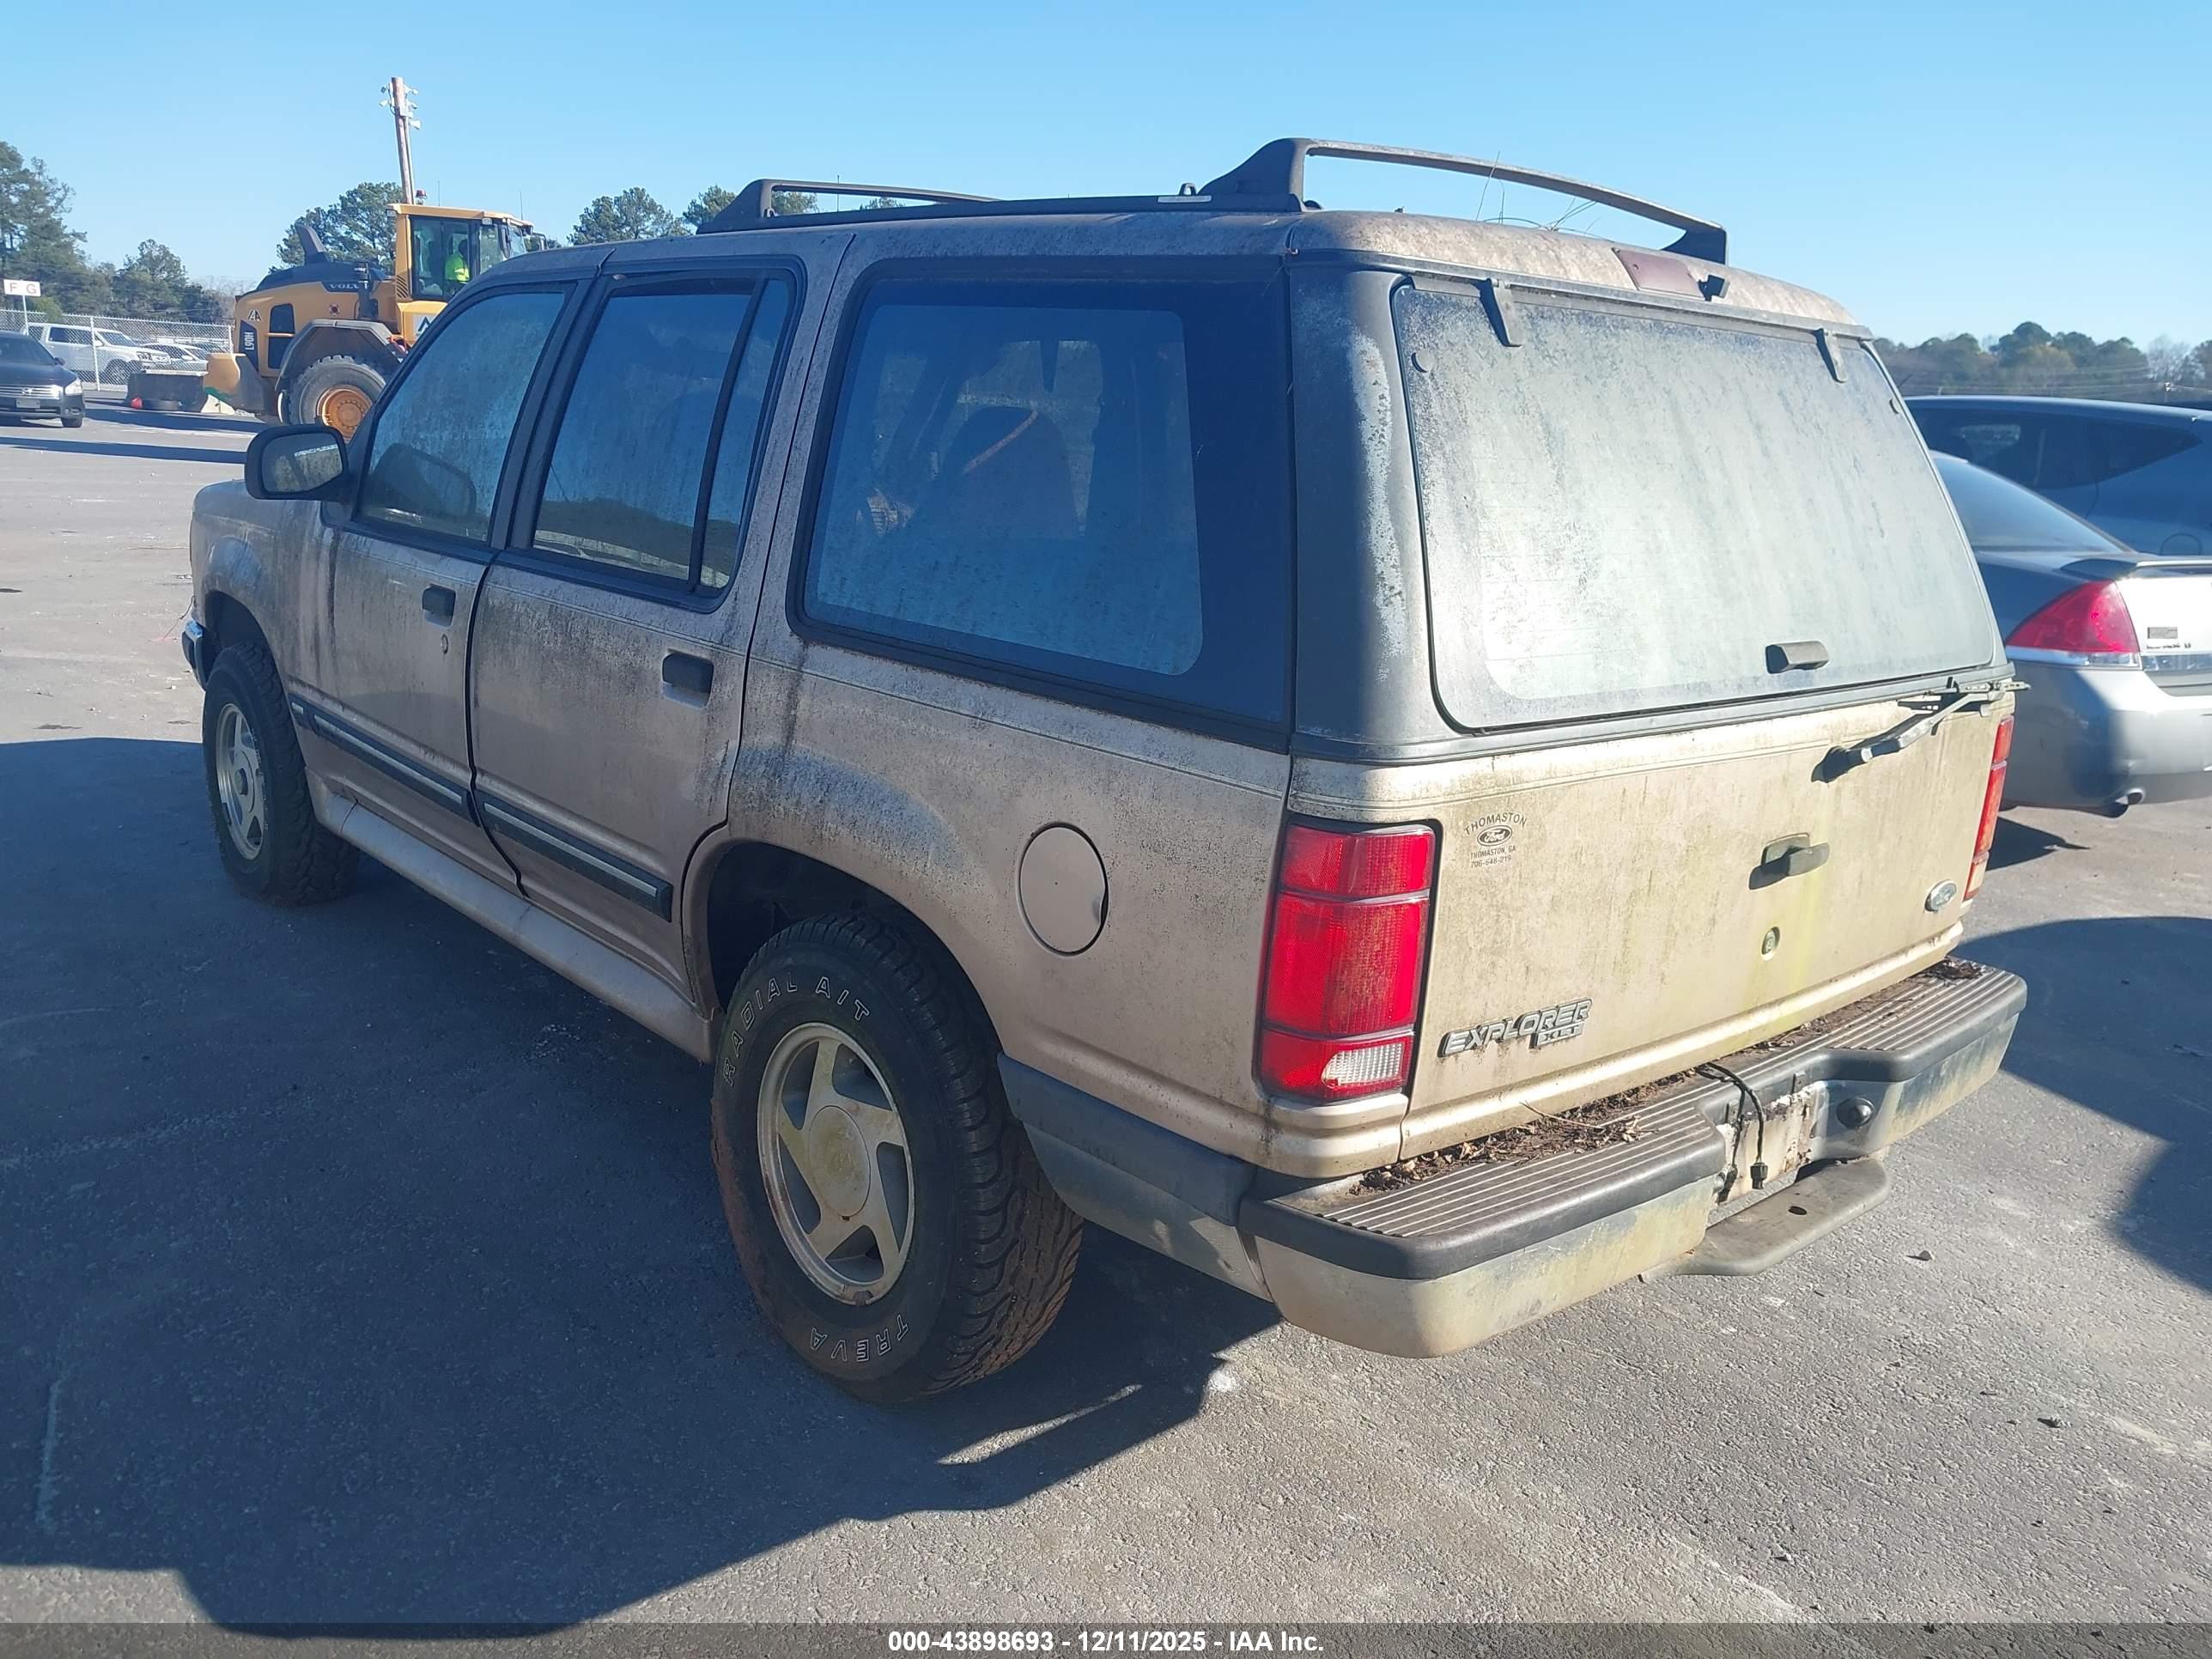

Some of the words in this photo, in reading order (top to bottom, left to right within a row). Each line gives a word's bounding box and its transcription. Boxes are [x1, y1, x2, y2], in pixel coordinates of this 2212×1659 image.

[9, 282, 18, 293] F
[26, 283, 37, 295] G
[244, 331, 255, 350] L90H
[1464, 811, 1528, 836] THOMASTON
[1508, 844, 1517, 853] GA
[723, 973, 799, 1088] RADIAL
[1439, 999, 1592, 1057] EXPLORER
[1540, 1022, 1583, 1045] XLT
[810, 1313, 909, 1362] TREVA
